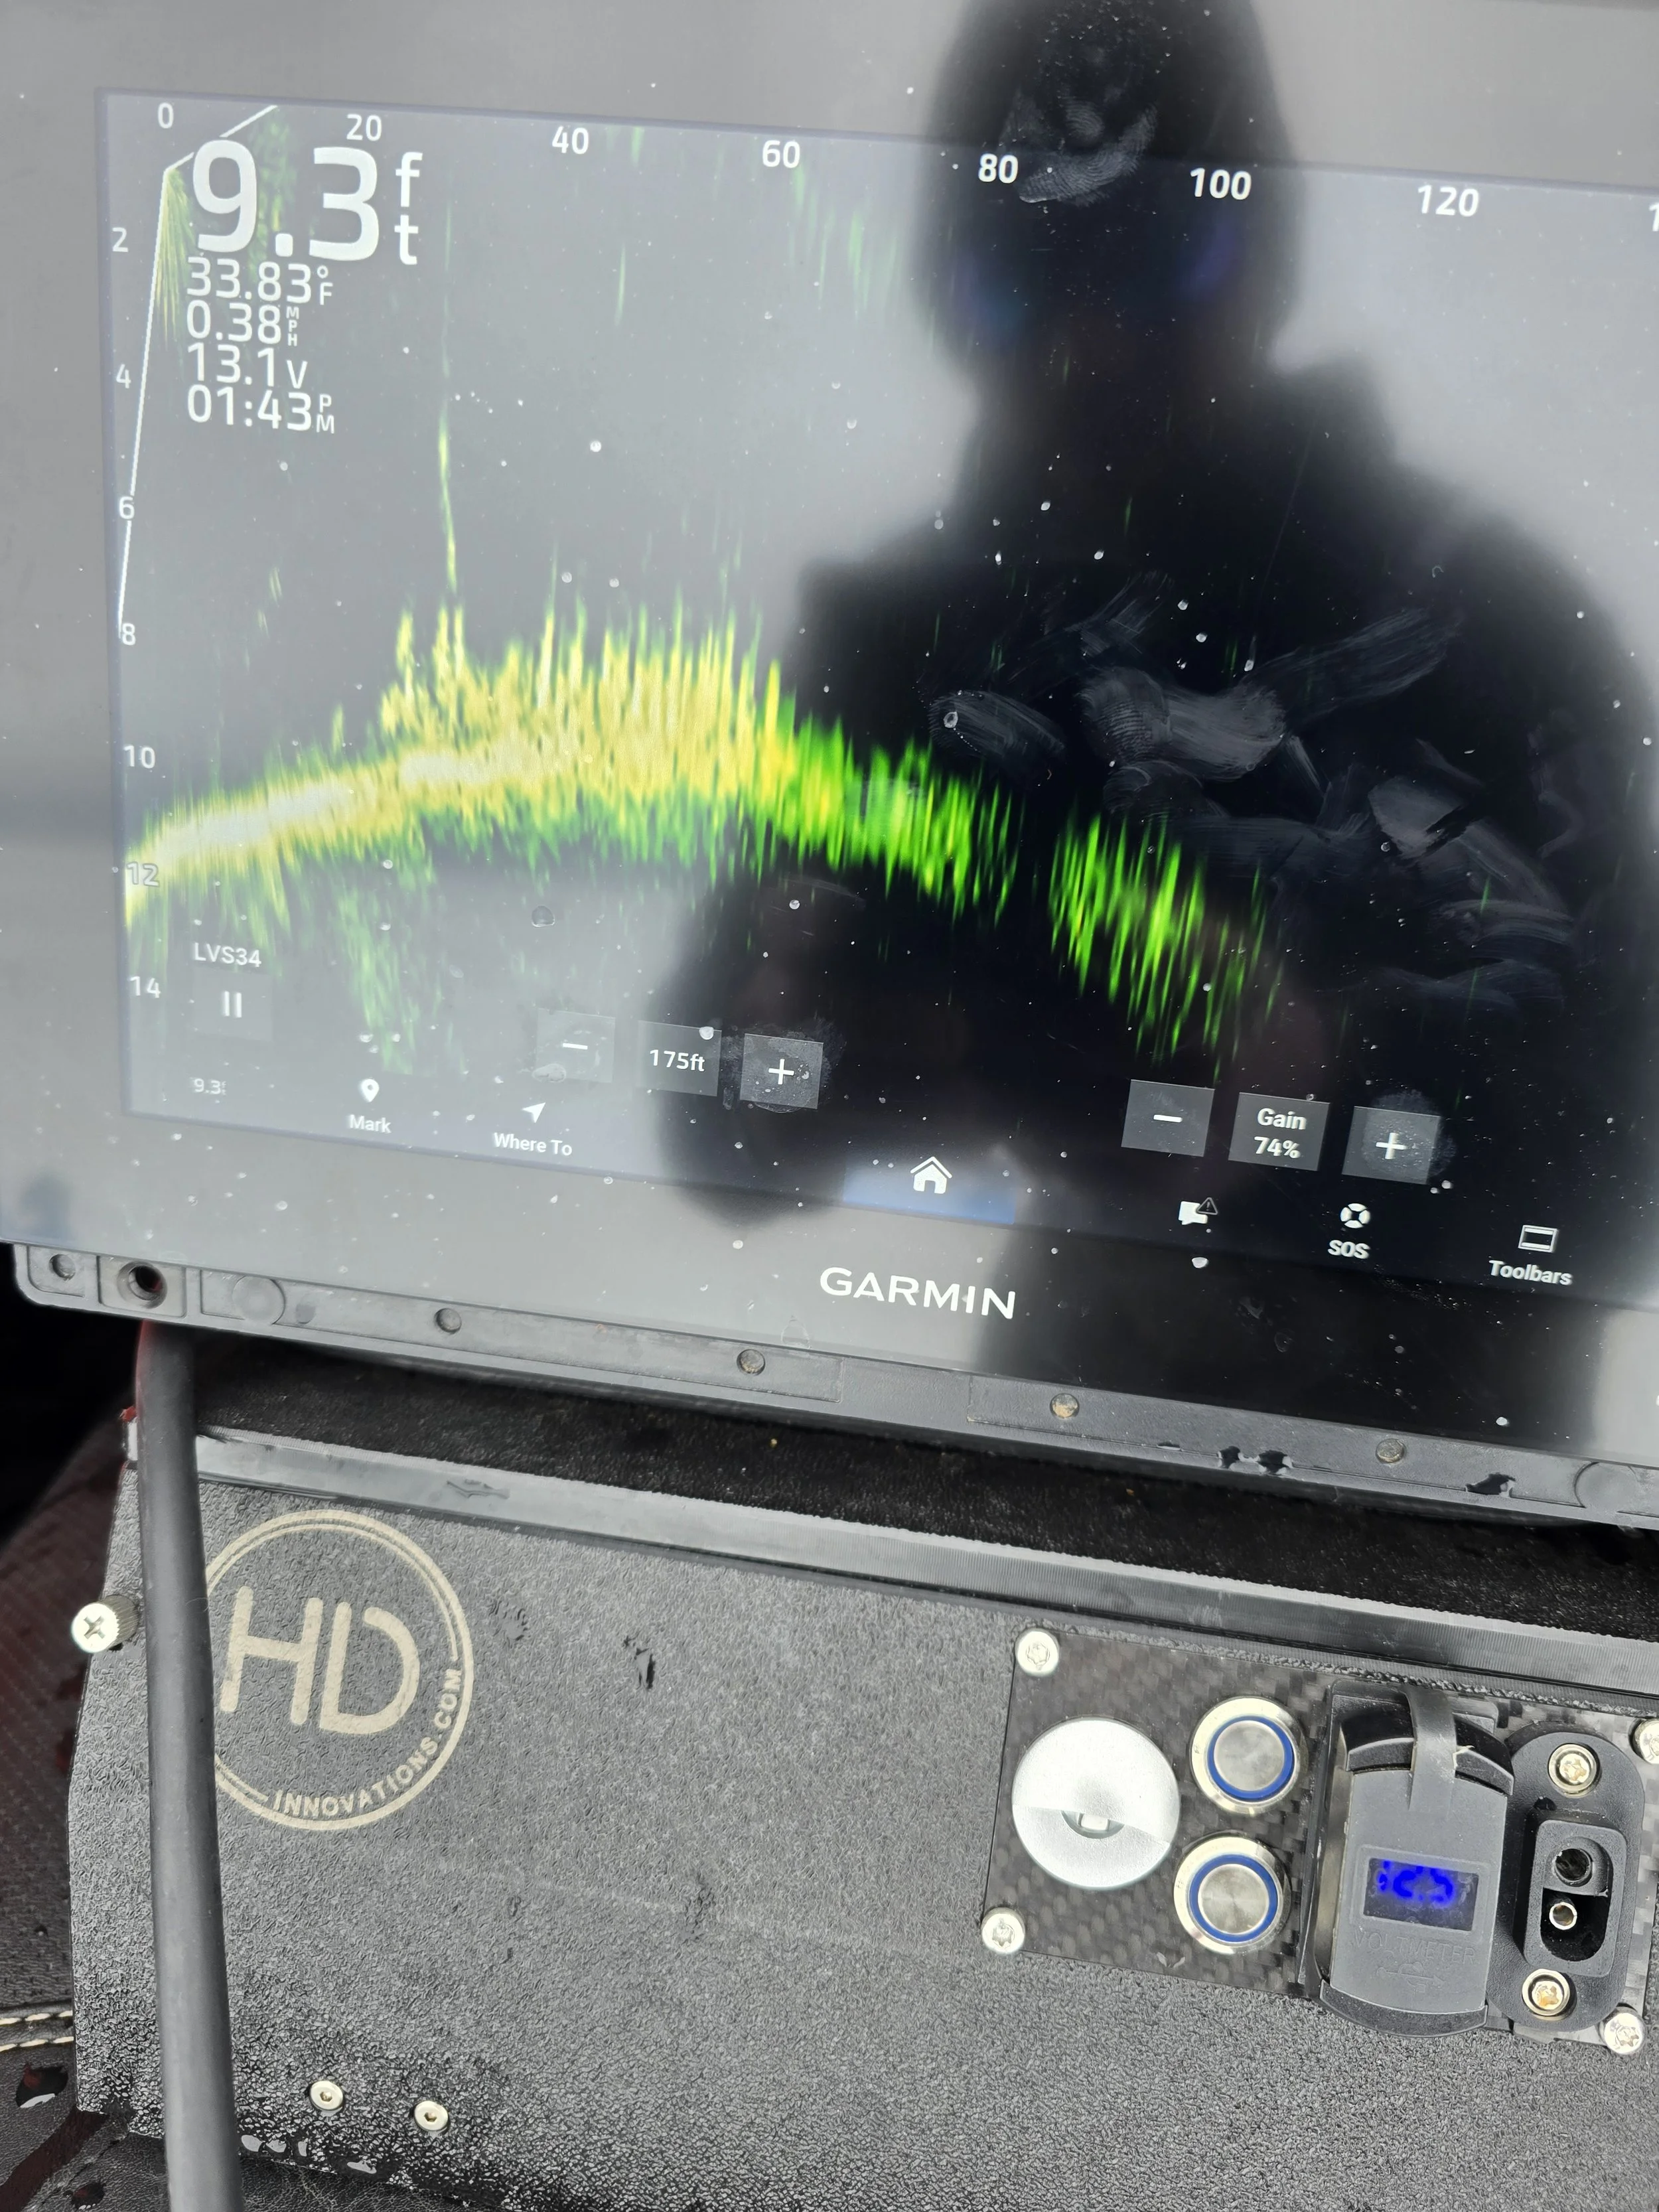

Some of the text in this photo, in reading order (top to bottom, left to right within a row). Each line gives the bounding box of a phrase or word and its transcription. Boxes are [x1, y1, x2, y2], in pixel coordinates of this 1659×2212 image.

[158, 103, 174, 129] 0
[346, 114, 382, 141] 20
[551, 126, 590, 155] 40
[761, 139, 801, 169] 60
[977, 153, 1019, 184] 80
[1190, 167, 1253, 200] 100
[193, 139, 379, 261] 9.3
[1417, 184, 1480, 217] 120
[111, 227, 129, 253] 2
[187, 256, 312, 304] 33.83
[187, 300, 282, 344] 0.38
[115, 363, 132, 389] 4
[187, 342, 309, 389] 13.1 V
[187, 384, 313, 431] 01:43
[119, 495, 135, 520] 6
[121, 622, 137, 646] 8
[123, 745, 155, 769] 10
[127, 861, 159, 887] 12
[193, 942, 262, 968] LVS34
[130, 975, 161, 999] 14
[649, 1049, 706, 1072] 175ft
[349, 1114, 392, 1134] Mark
[1257, 1107, 1307, 1132] Gain
[494, 1132, 573, 1157] Where To
[1254, 1136, 1301, 1159] 74%
[1327, 1238, 1371, 1260] SOS
[1488, 1259, 1573, 1288] Toolbars
[820, 1266, 1016, 1320] GARMIN
[220, 1585, 420, 1735] HD
